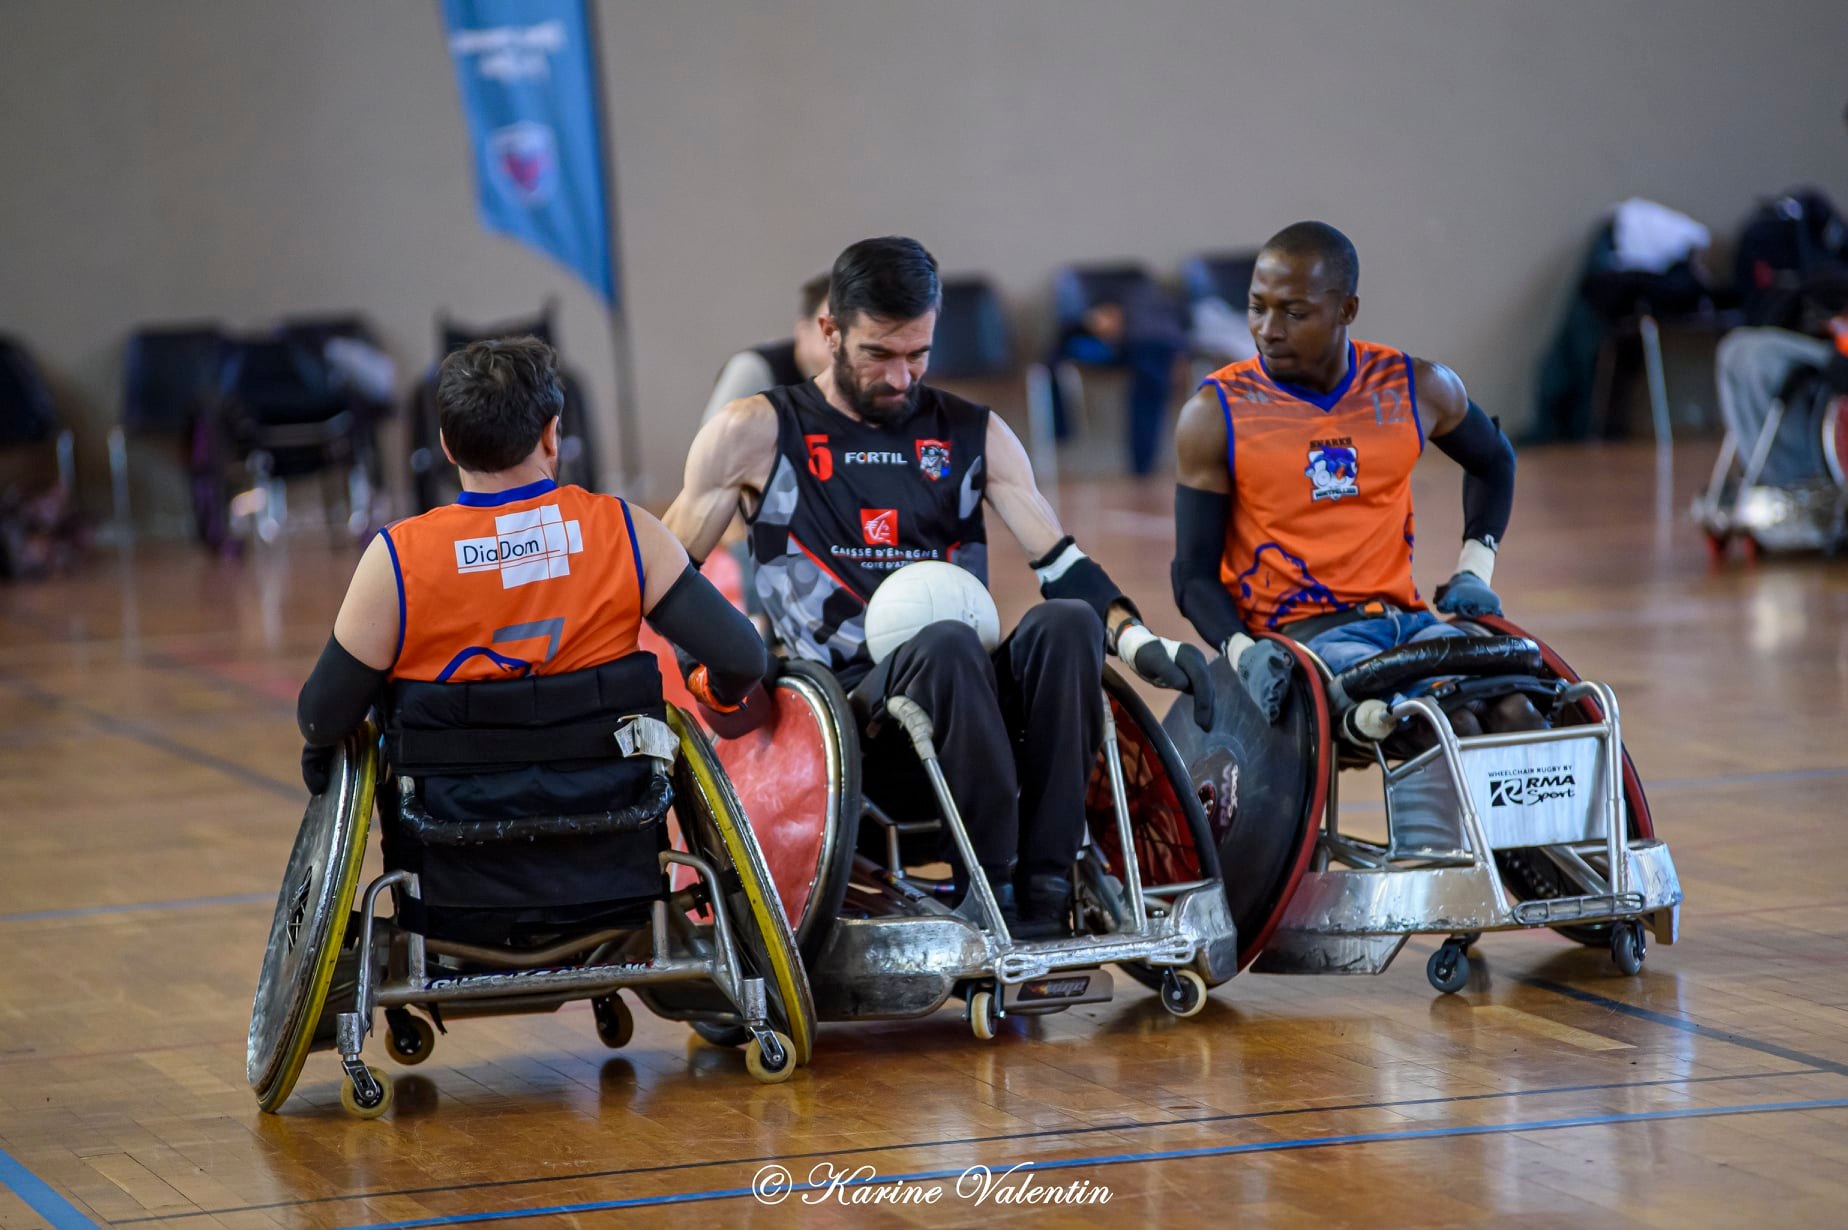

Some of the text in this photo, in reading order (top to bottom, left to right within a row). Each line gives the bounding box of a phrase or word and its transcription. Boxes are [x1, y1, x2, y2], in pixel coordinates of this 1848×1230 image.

[1371, 387, 1407, 426] 12
[804, 433, 833, 482] 5
[844, 451, 908, 465] FORTIL
[463, 538, 540, 566] DiaDom
[830, 545, 872, 557] CAISSE
[491, 616, 566, 669] 7
[1488, 768, 1534, 777] WHEELCHAIR
[1526, 774, 1576, 788] RMA
[1527, 788, 1575, 806] Sport
